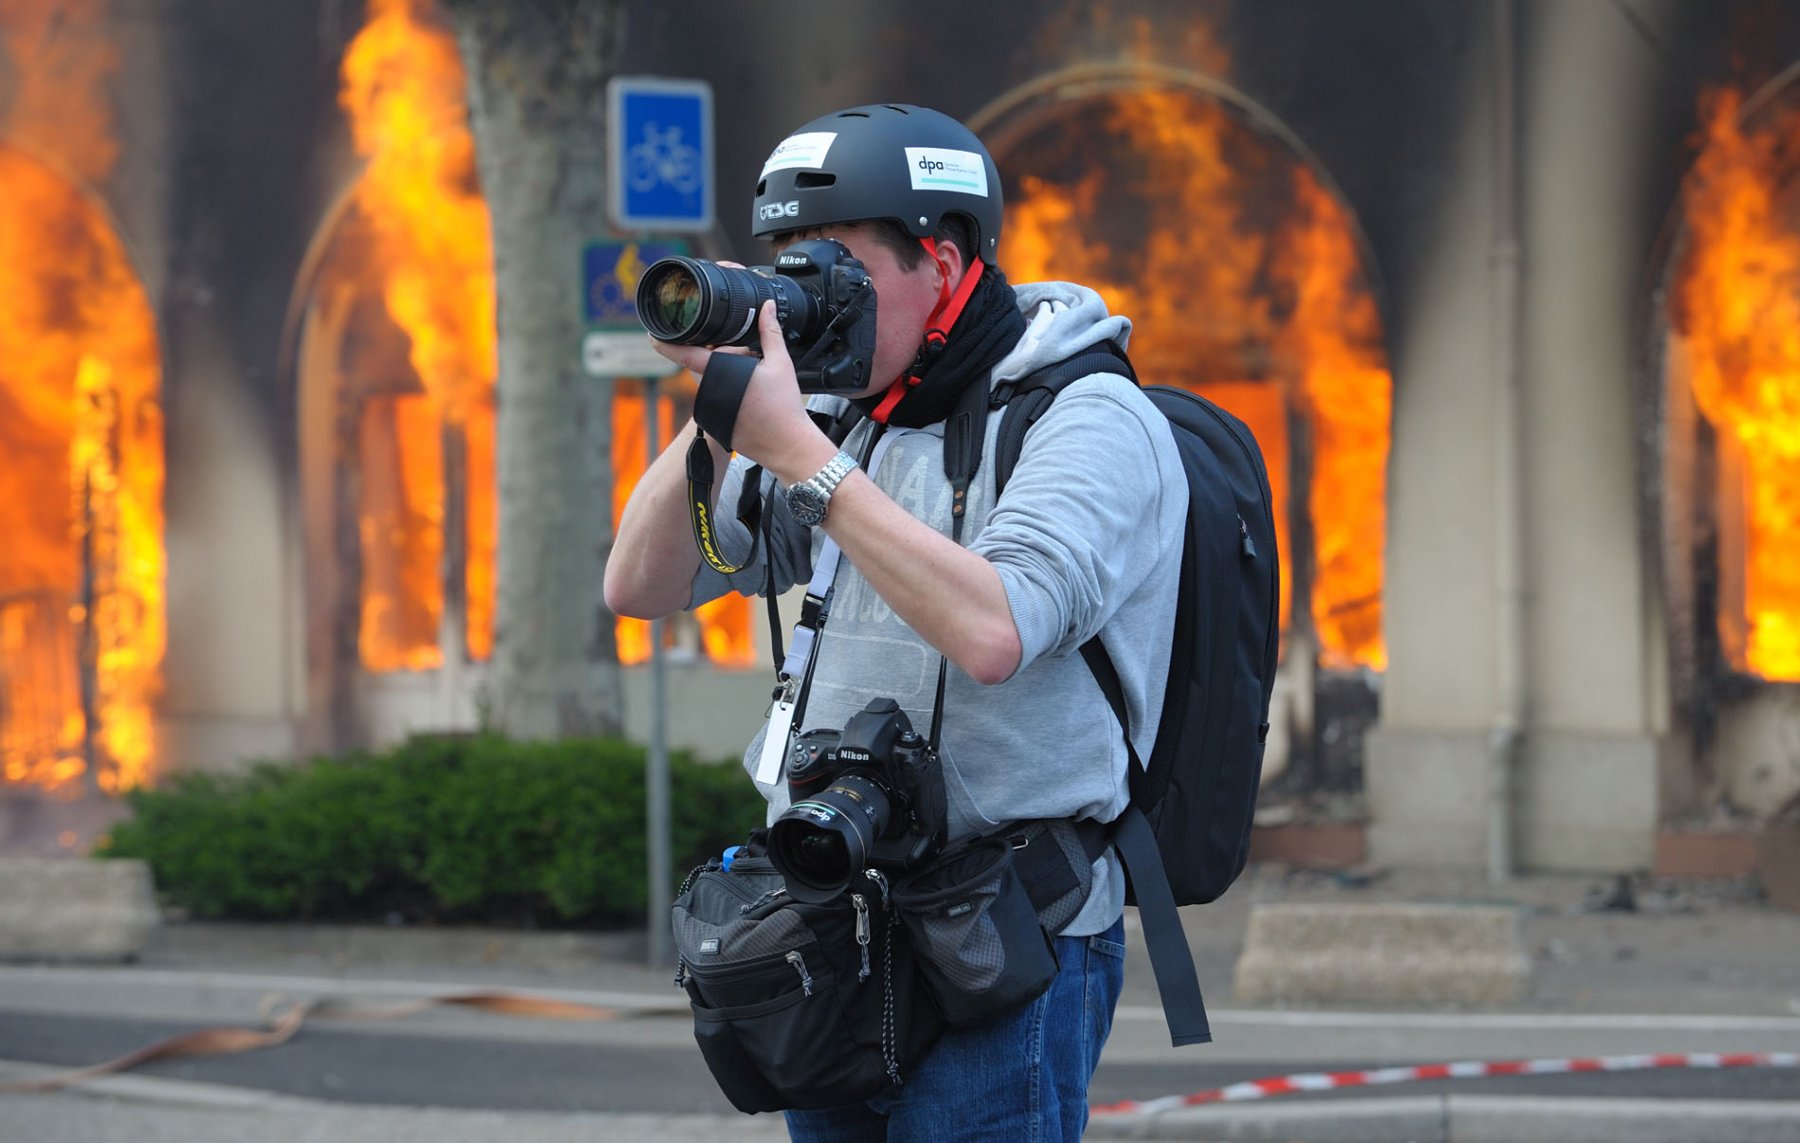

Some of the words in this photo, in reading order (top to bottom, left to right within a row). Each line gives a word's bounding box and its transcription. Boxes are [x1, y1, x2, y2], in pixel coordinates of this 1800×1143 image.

[919, 155, 944, 175] dpa
[766, 200, 800, 219] TSG
[780, 255, 807, 265] Nikon
[840, 750, 869, 761] Nikon
[810, 809, 831, 821] dpa
